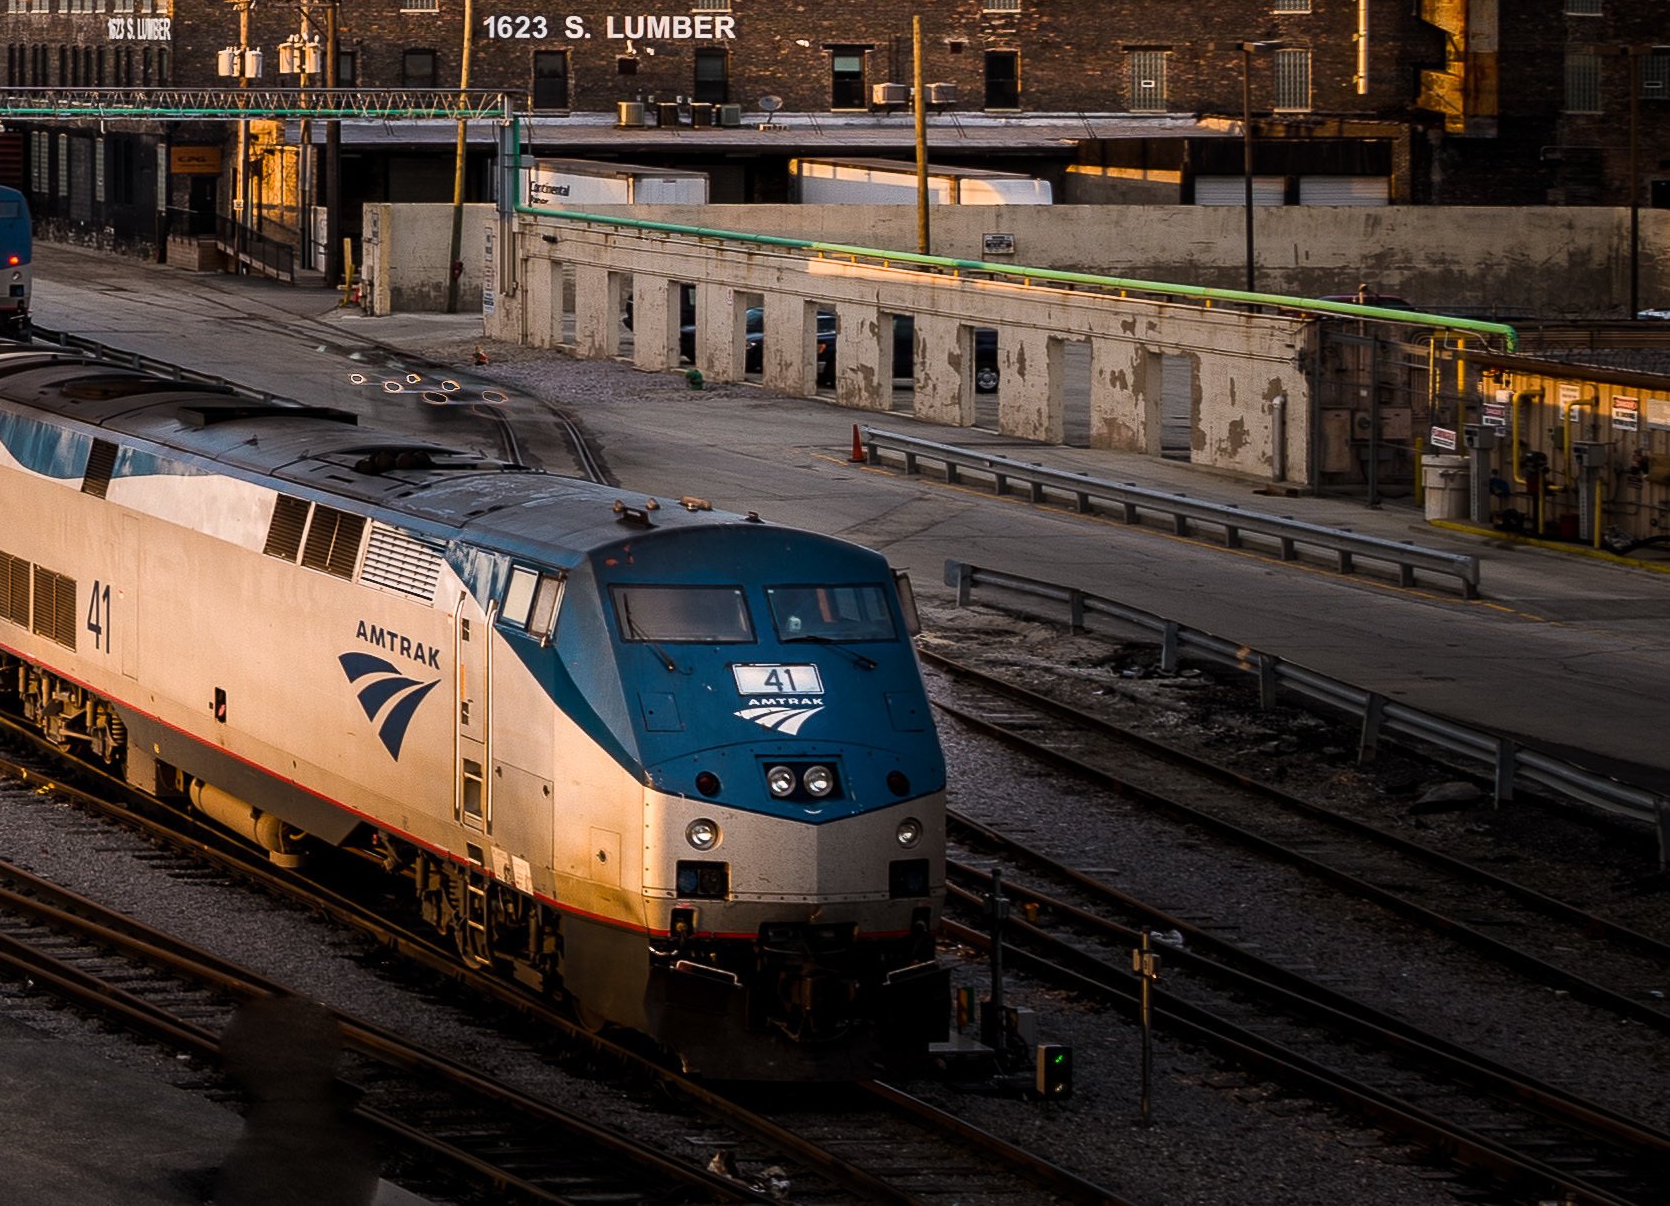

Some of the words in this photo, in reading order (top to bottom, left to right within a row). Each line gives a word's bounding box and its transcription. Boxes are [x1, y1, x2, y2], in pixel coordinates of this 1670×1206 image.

[137, 18, 171, 40] LUMBER
[484, 16, 548, 39] 1623
[565, 16, 590, 39] S.
[606, 16, 736, 39] LUMBER
[530, 181, 571, 197] Continental
[86, 579, 111, 654] 41
[356, 620, 441, 670] AMTRAK
[763, 668, 797, 692] 41
[747, 698, 824, 707] AMTRAK
